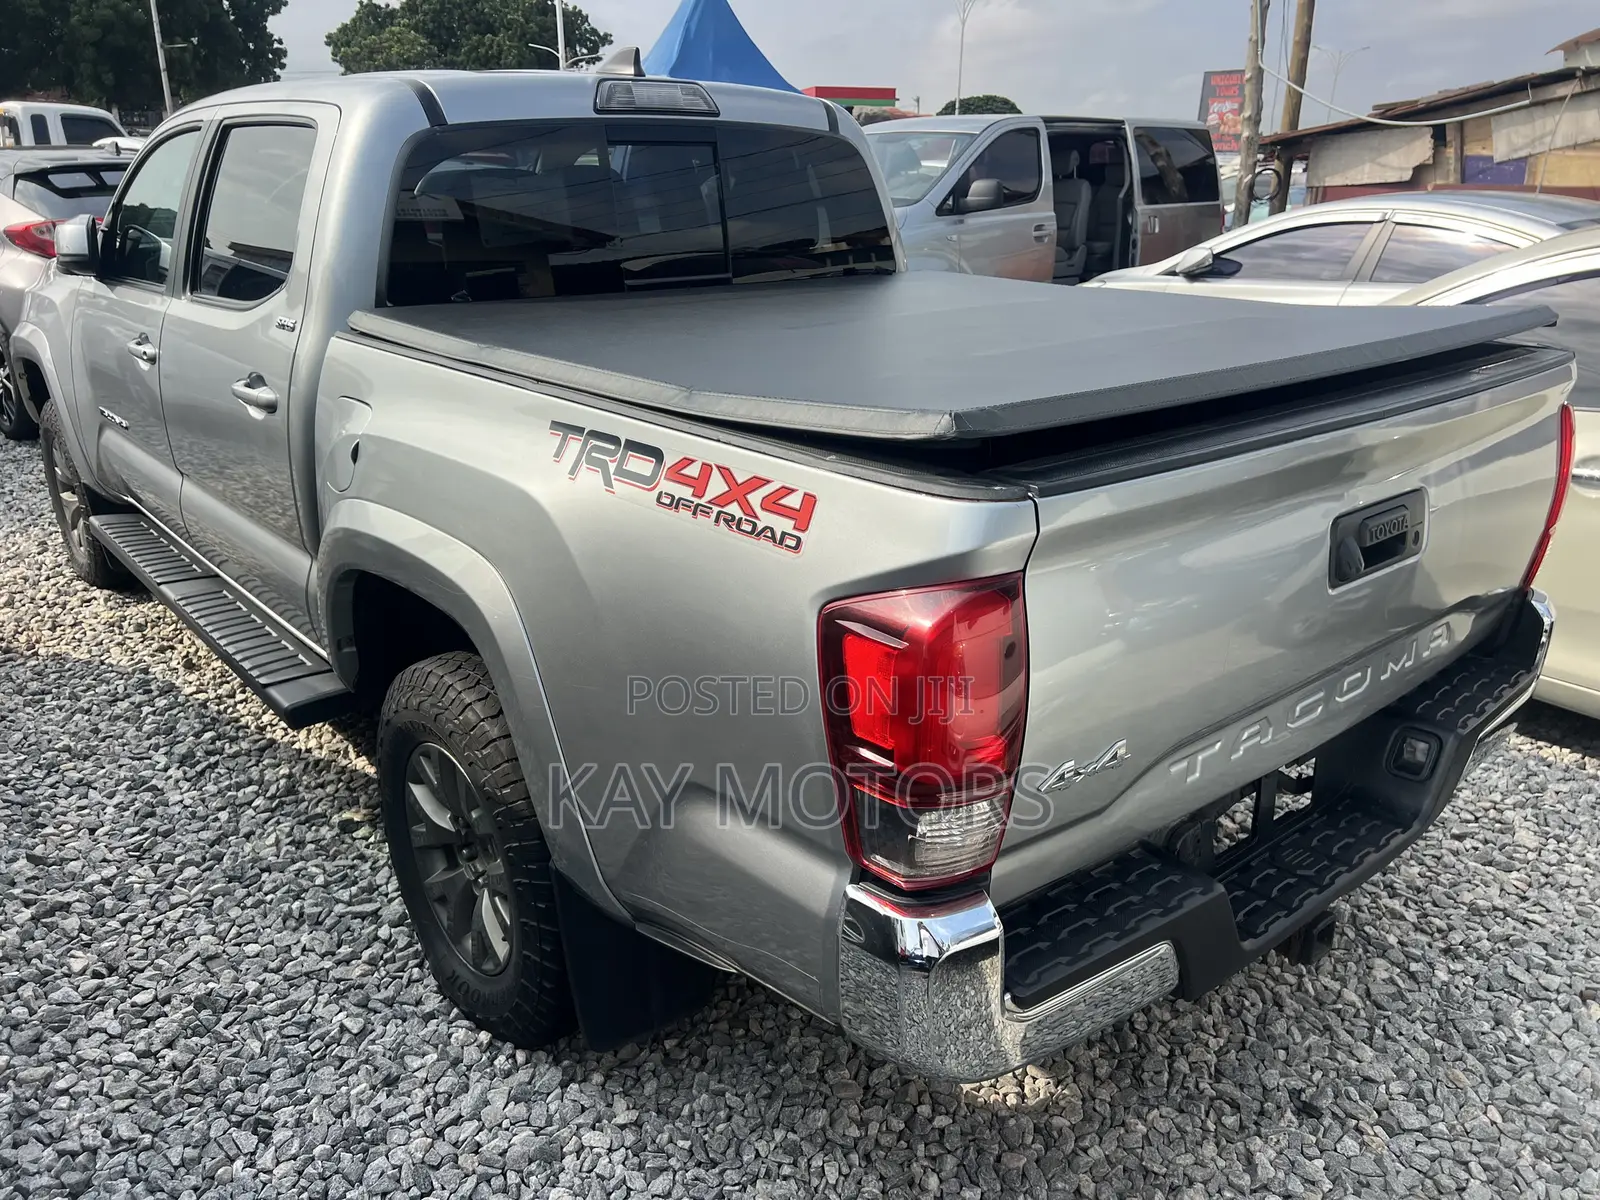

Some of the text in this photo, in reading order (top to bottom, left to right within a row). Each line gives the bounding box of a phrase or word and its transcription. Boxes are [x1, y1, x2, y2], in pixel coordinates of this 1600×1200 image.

[549, 420, 665, 494] TRD
[656, 490, 804, 554] OFF ROAD
[1370, 514, 1409, 541] TOYOTA
[1169, 621, 1451, 783] TACOMA
[1037, 738, 1131, 793] 4x4
